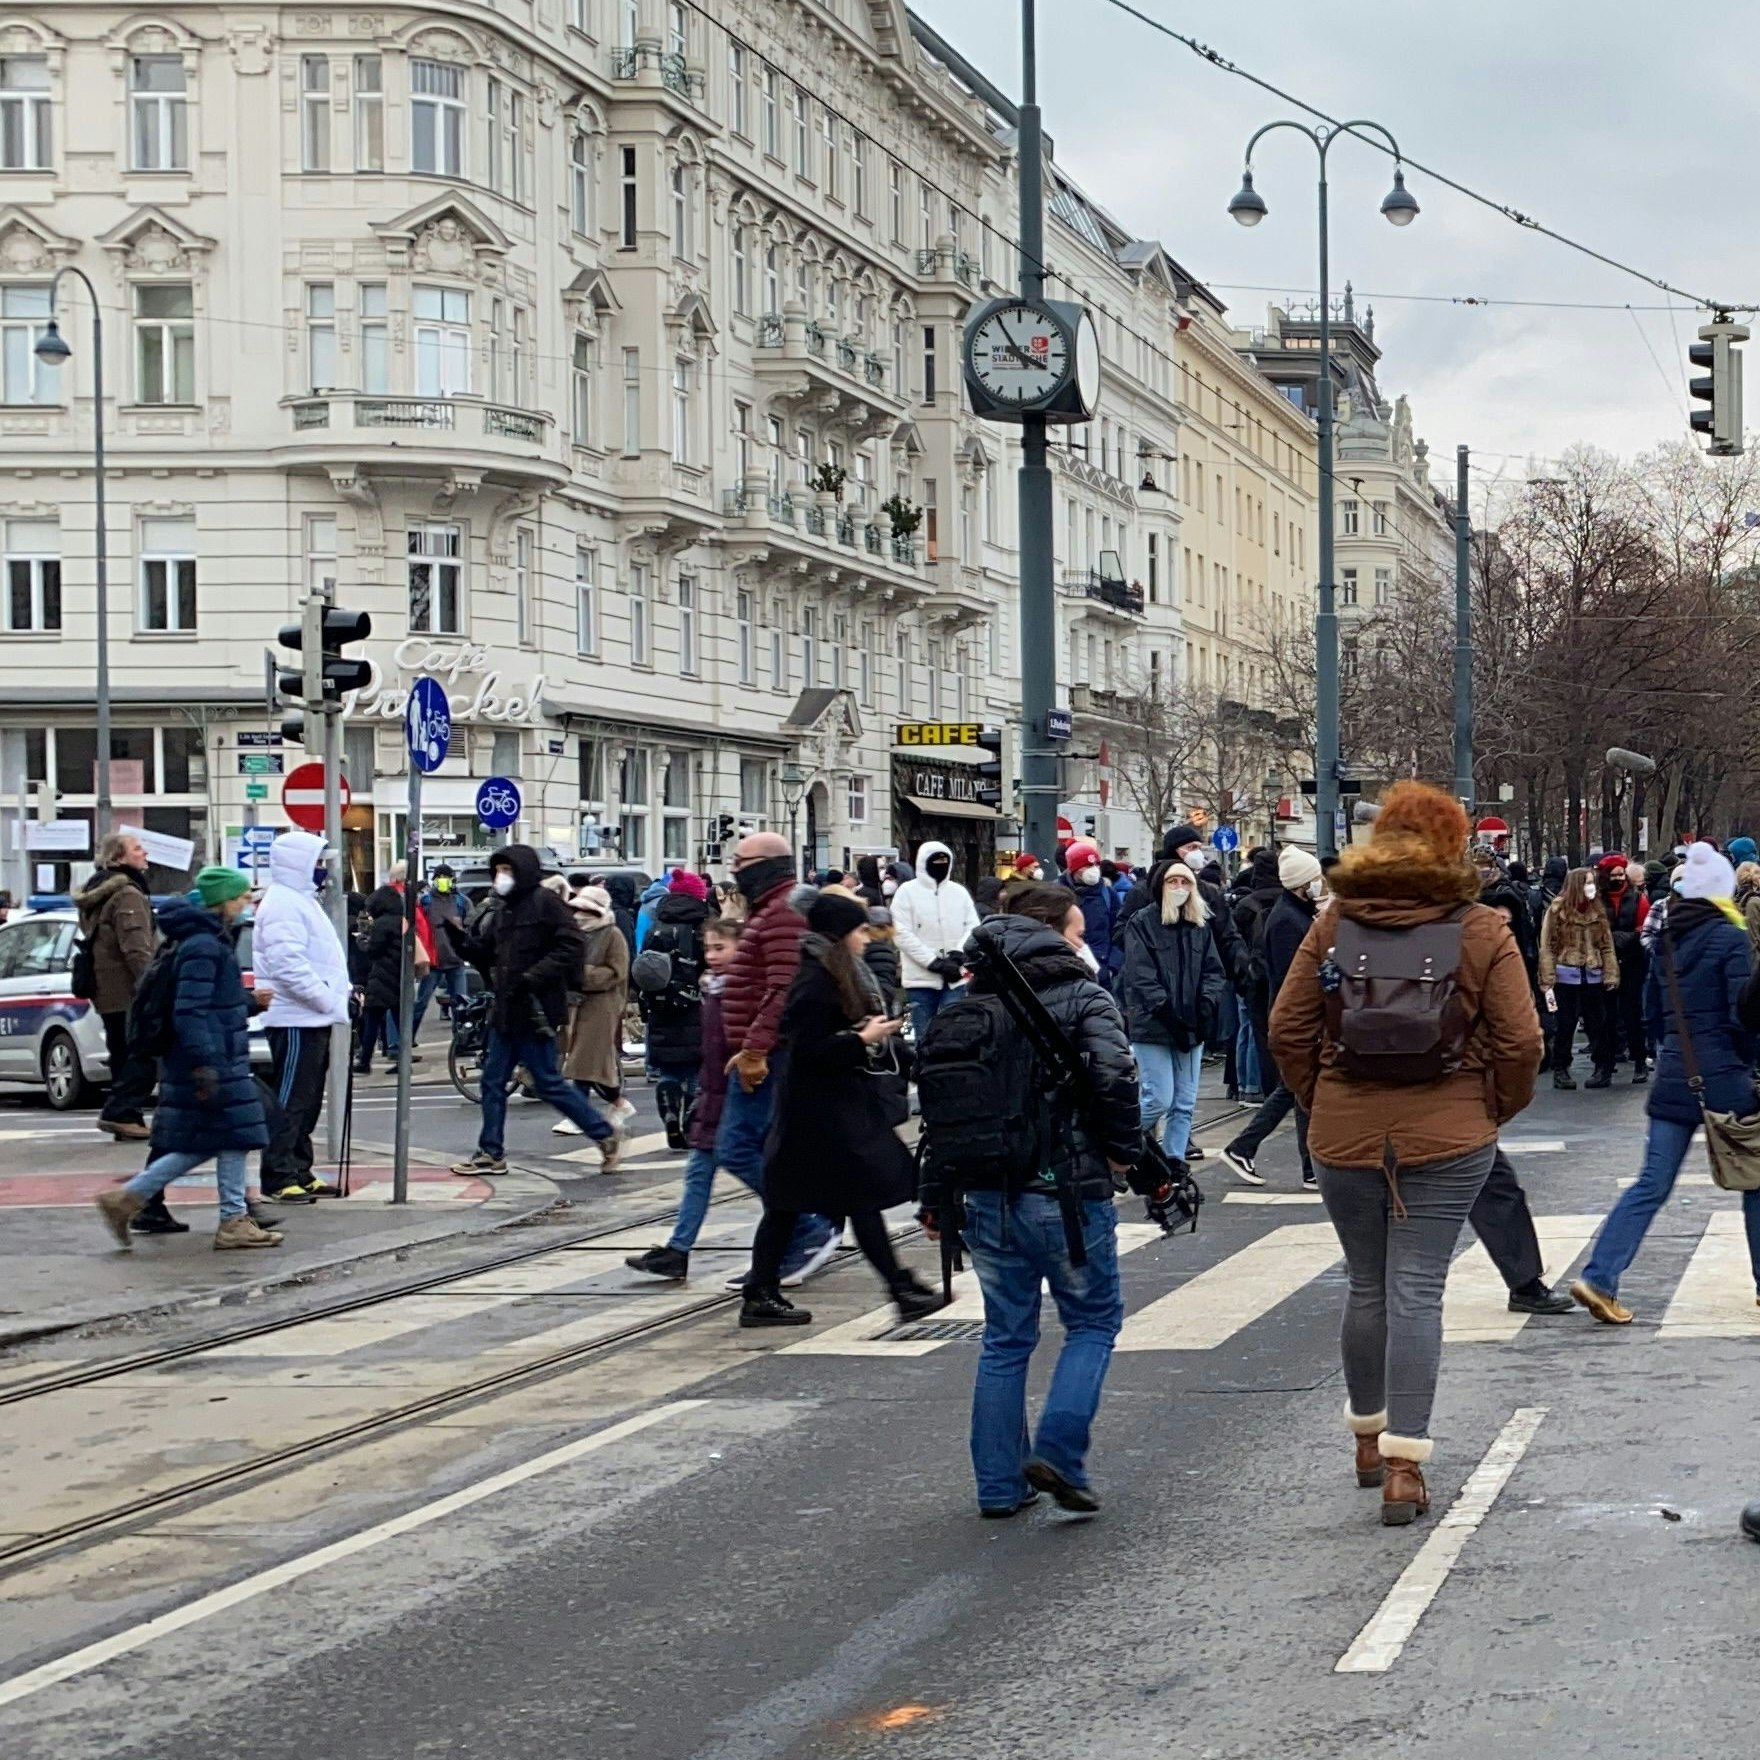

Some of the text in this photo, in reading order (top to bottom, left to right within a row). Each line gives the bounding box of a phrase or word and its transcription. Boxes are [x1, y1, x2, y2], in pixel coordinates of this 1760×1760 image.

[992, 345, 1030, 353] WIER
[992, 354, 1048, 363] STDTCHE
[394, 638, 491, 685] Café
[901, 724, 978, 745] CAFE
[916, 773, 944, 798] CAFE
